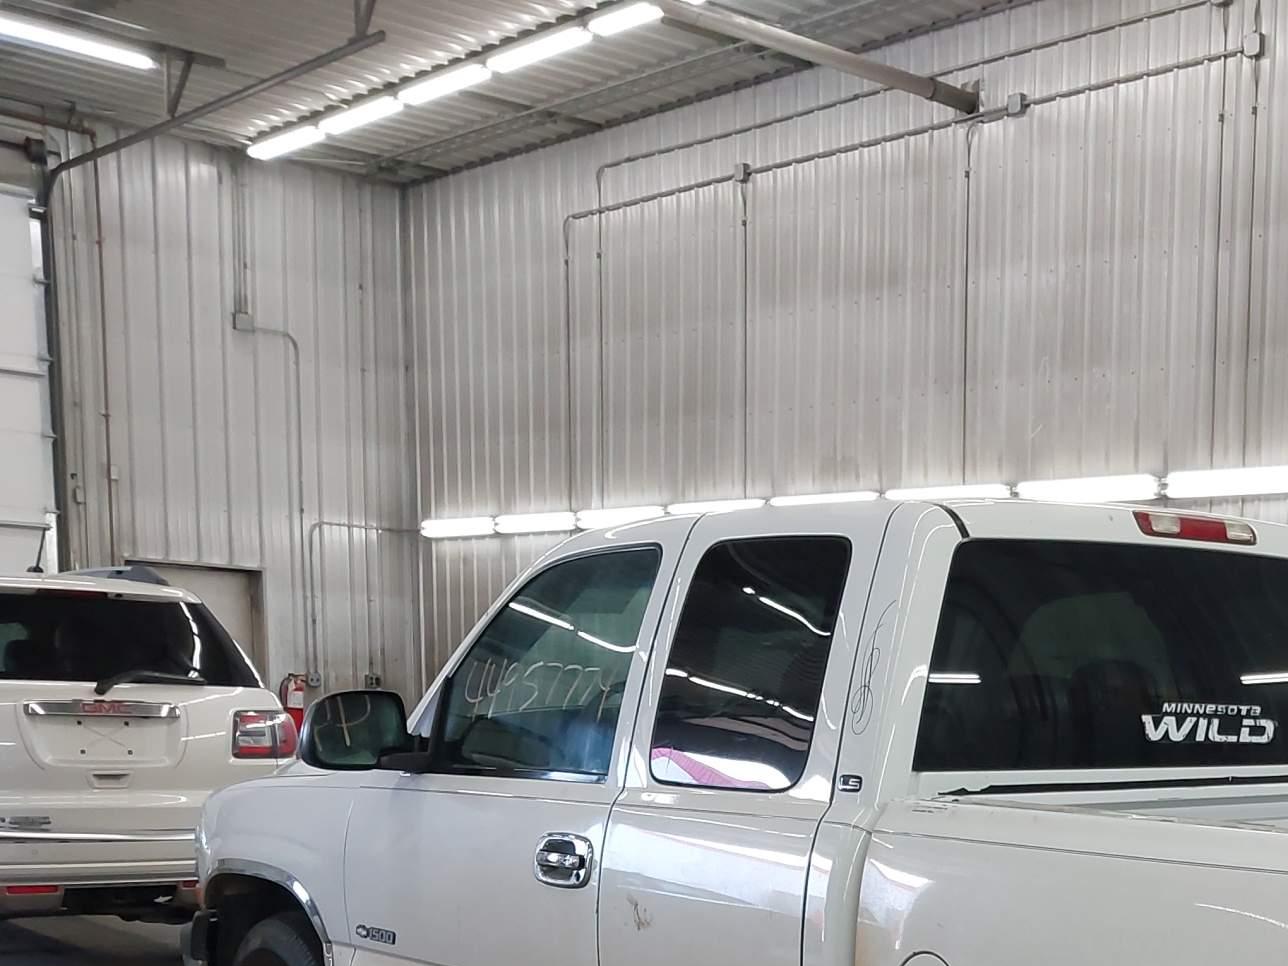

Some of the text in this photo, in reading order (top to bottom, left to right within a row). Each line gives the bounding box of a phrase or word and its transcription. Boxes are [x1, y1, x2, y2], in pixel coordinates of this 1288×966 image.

[81, 702, 132, 714] GMC
[1141, 714, 1276, 744] WILD
[838, 776, 861, 791] LS
[369, 927, 395, 945] 1500
